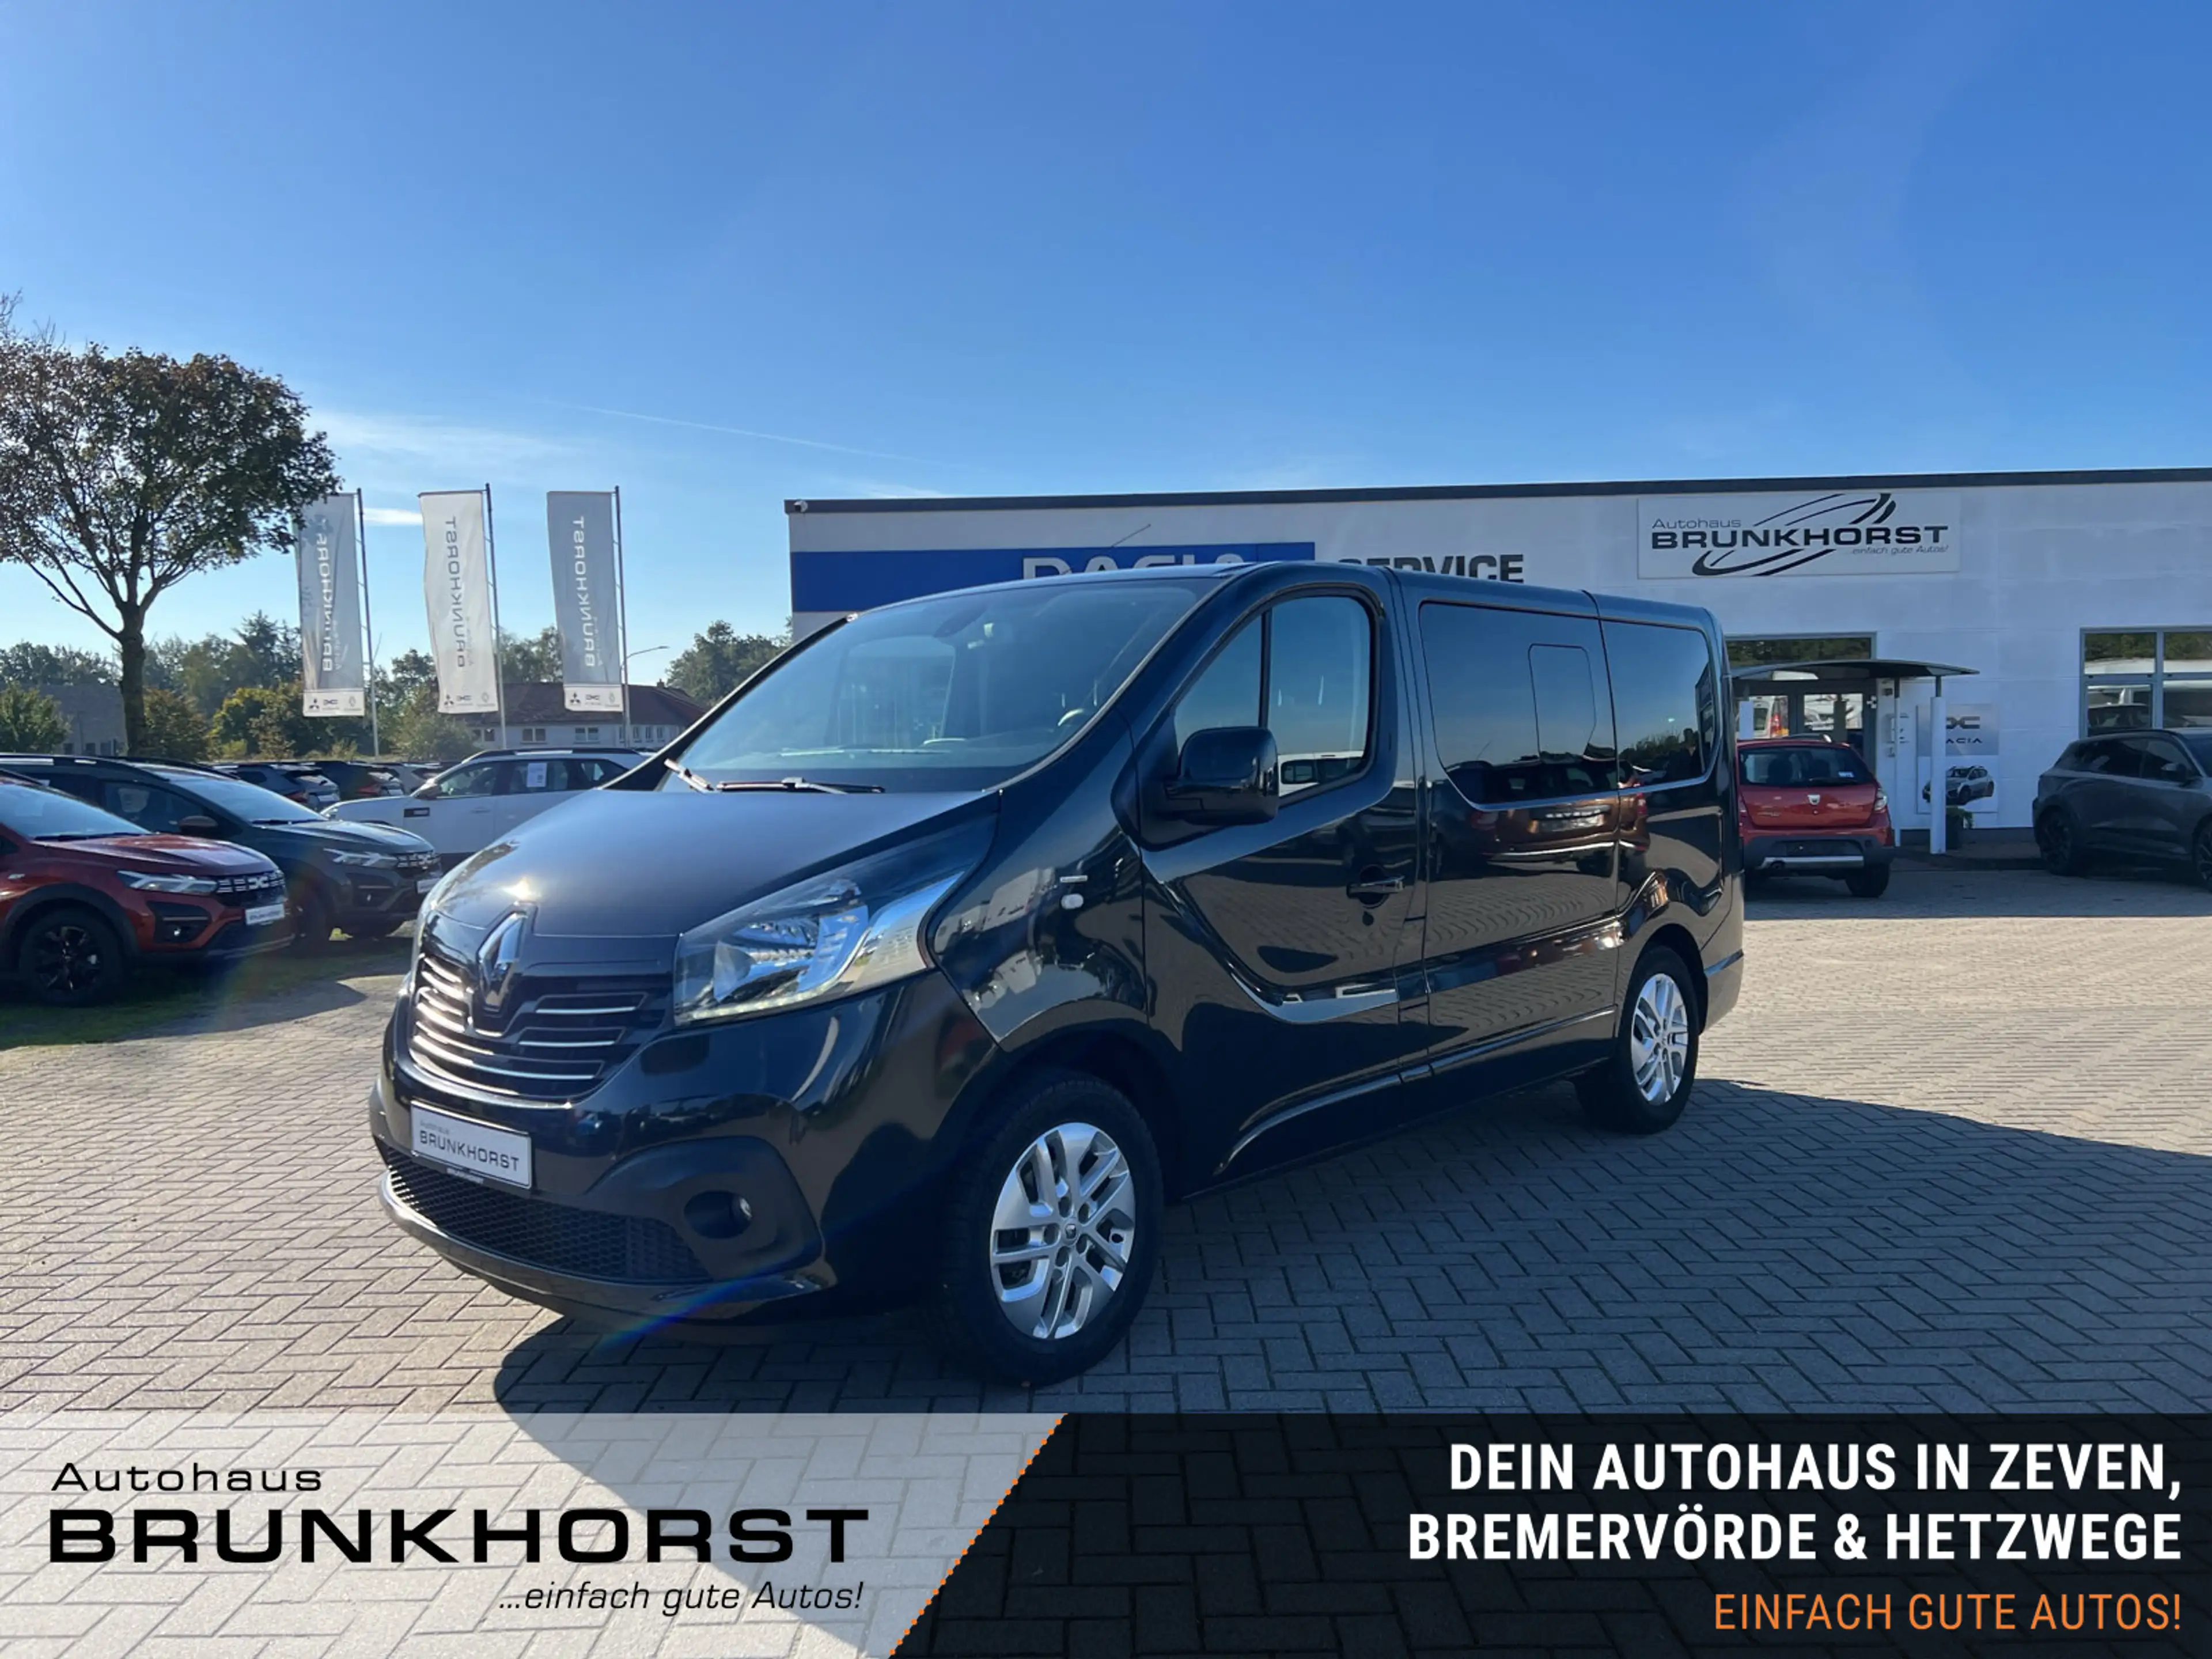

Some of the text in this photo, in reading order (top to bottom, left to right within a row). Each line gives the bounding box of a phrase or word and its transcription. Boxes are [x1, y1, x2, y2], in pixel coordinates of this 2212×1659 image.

[1652, 518, 1741, 529] Autohaus
[1652, 526, 1948, 549] BRUNKHORST
[1339, 554, 1524, 583] VICE
[420, 1130, 520, 1171] BRUNKHORST
